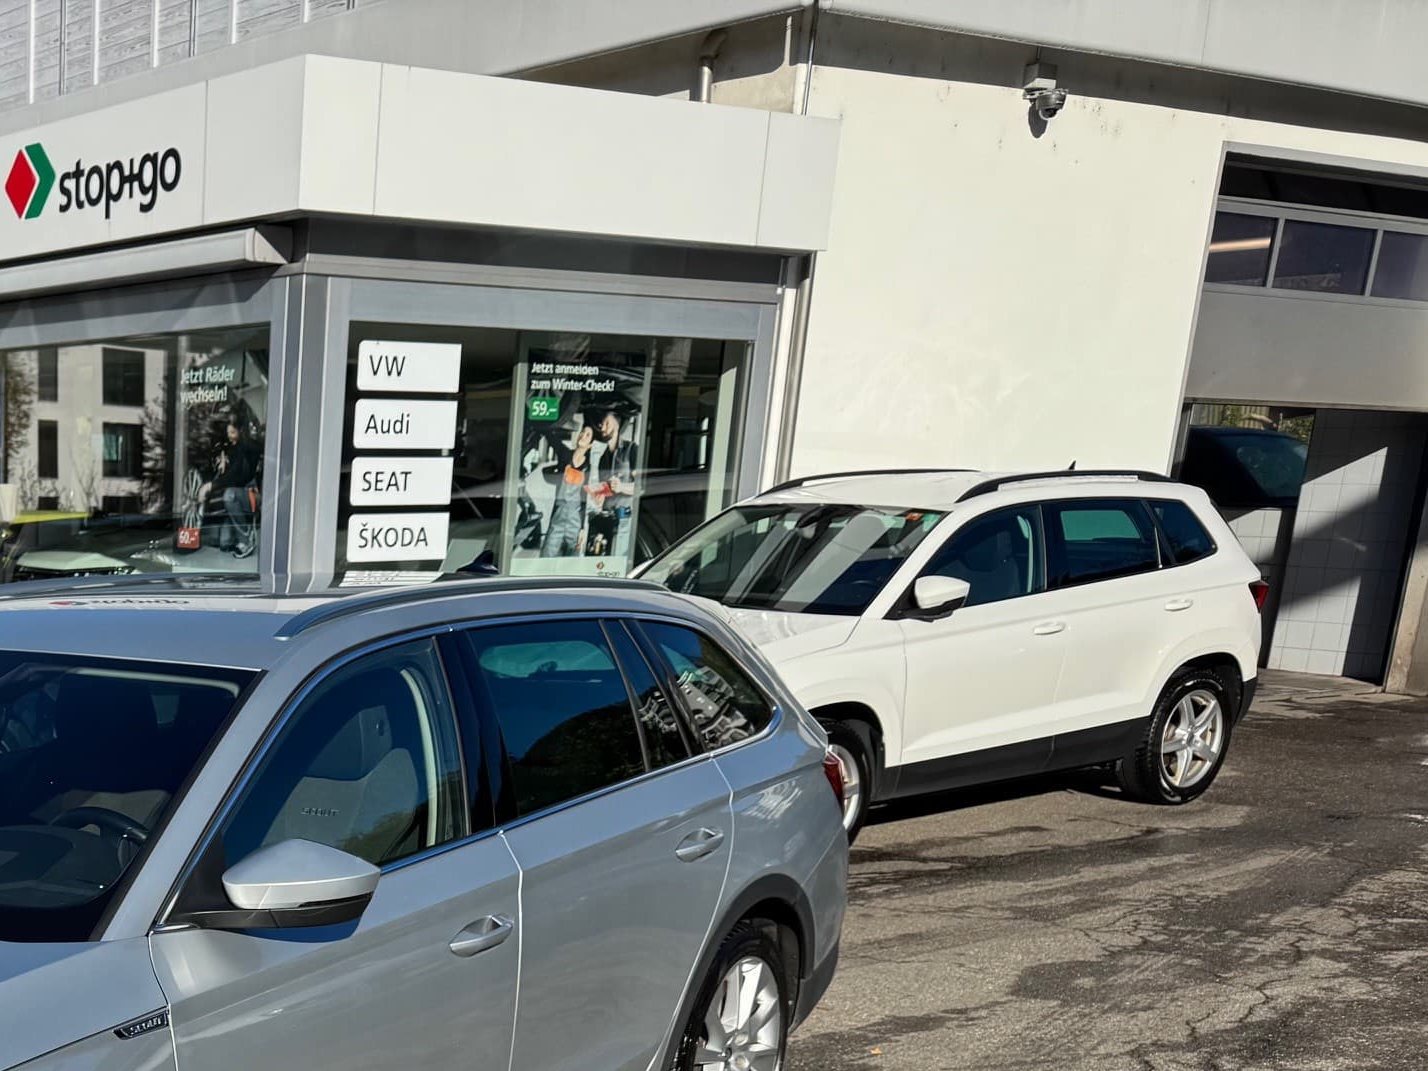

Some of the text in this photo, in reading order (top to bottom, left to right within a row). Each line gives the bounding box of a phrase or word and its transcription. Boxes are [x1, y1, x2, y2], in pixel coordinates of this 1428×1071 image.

[59, 147, 181, 219] stop+go
[181, 364, 235, 384] Jetzt Räder
[370, 354, 406, 377] VW
[531, 362, 599, 375] Jetzt anmelden
[530, 378, 615, 392] zum Winter-Check!
[365, 412, 410, 435] Audi
[362, 471, 412, 492] SEAT
[358, 522, 428, 548] ŠKODA
[301, 807, 340, 817] SCOUT
